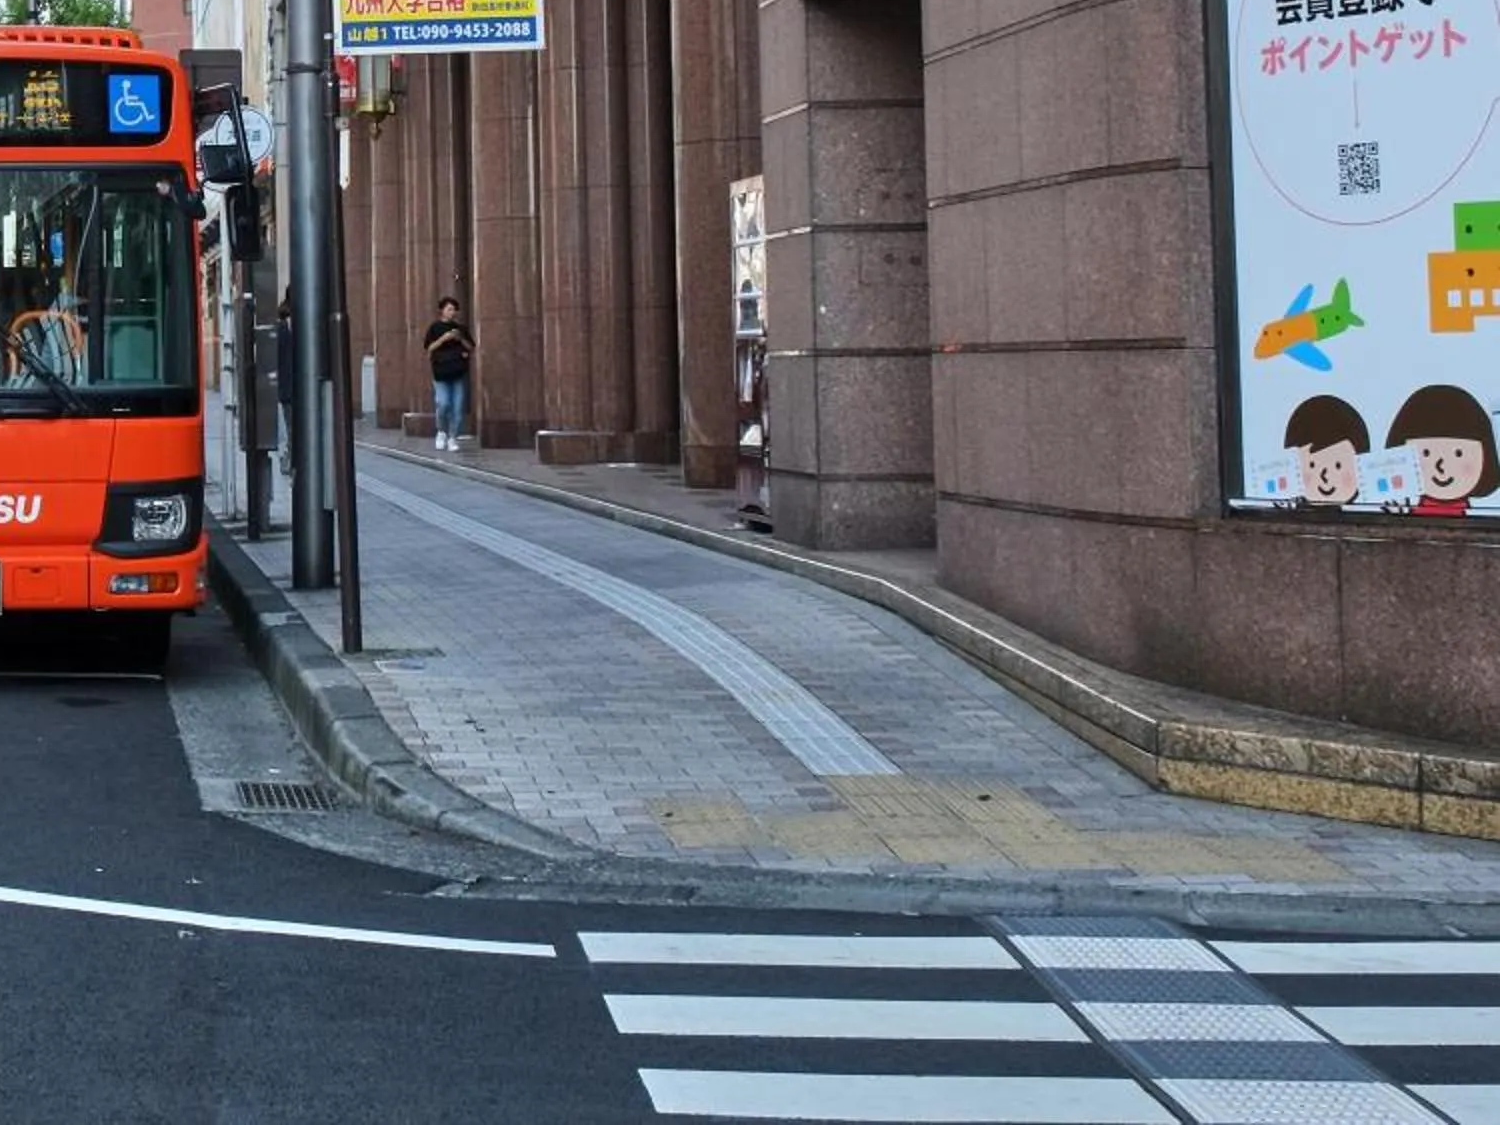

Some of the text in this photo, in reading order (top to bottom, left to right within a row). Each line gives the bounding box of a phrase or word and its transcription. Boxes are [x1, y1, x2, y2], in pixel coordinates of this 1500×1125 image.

[392, 22, 531, 41] TEL:090-9453-2088
[1260, 18, 1467, 76] ポイントゲット
